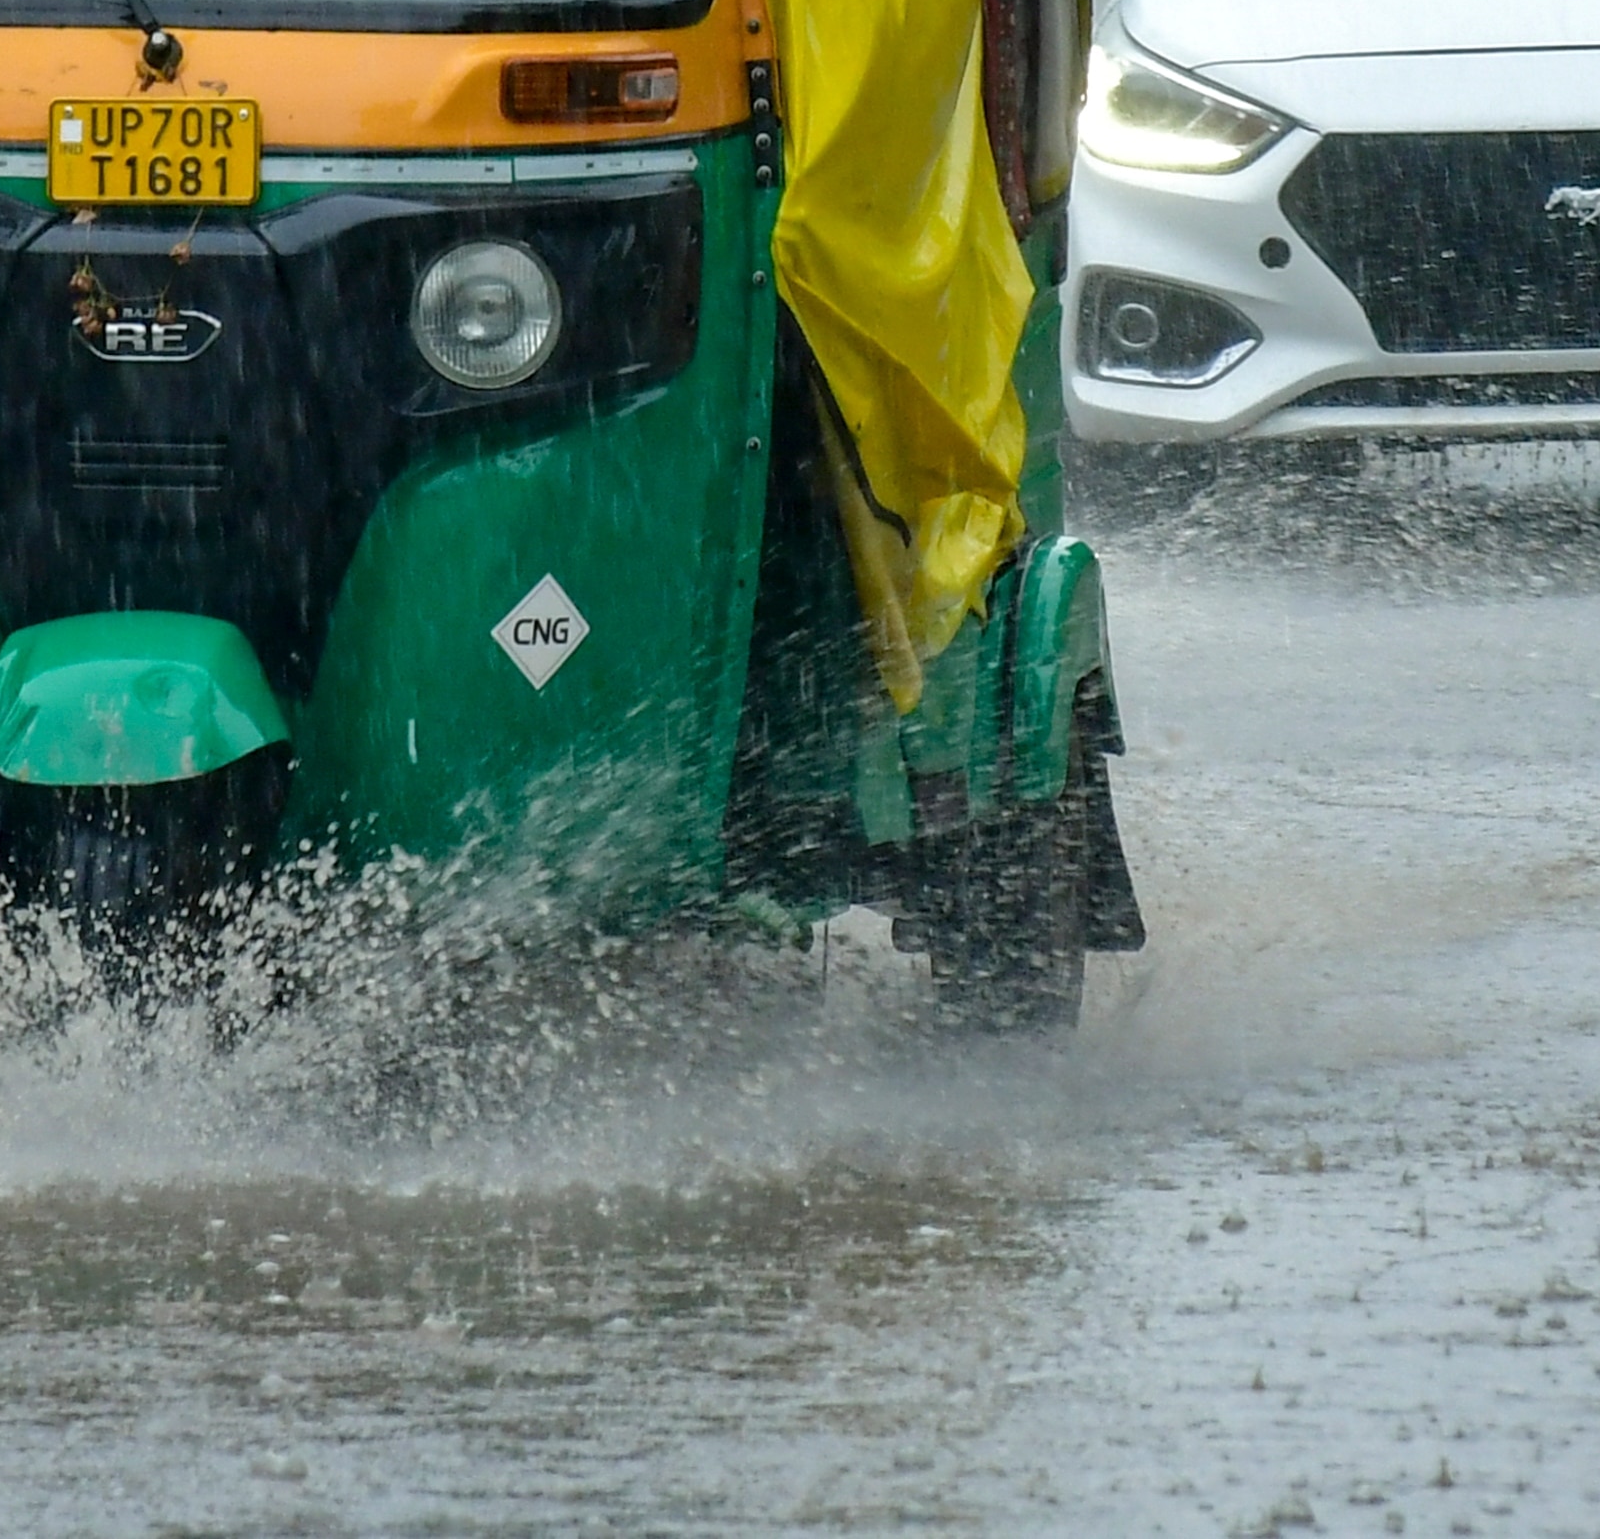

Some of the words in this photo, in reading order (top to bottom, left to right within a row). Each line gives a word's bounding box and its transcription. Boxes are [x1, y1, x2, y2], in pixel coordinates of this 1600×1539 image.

[91, 107, 233, 148] UP70R
[91, 156, 228, 196] T1681
[105, 323, 188, 351] RE
[513, 617, 570, 645] CNG
